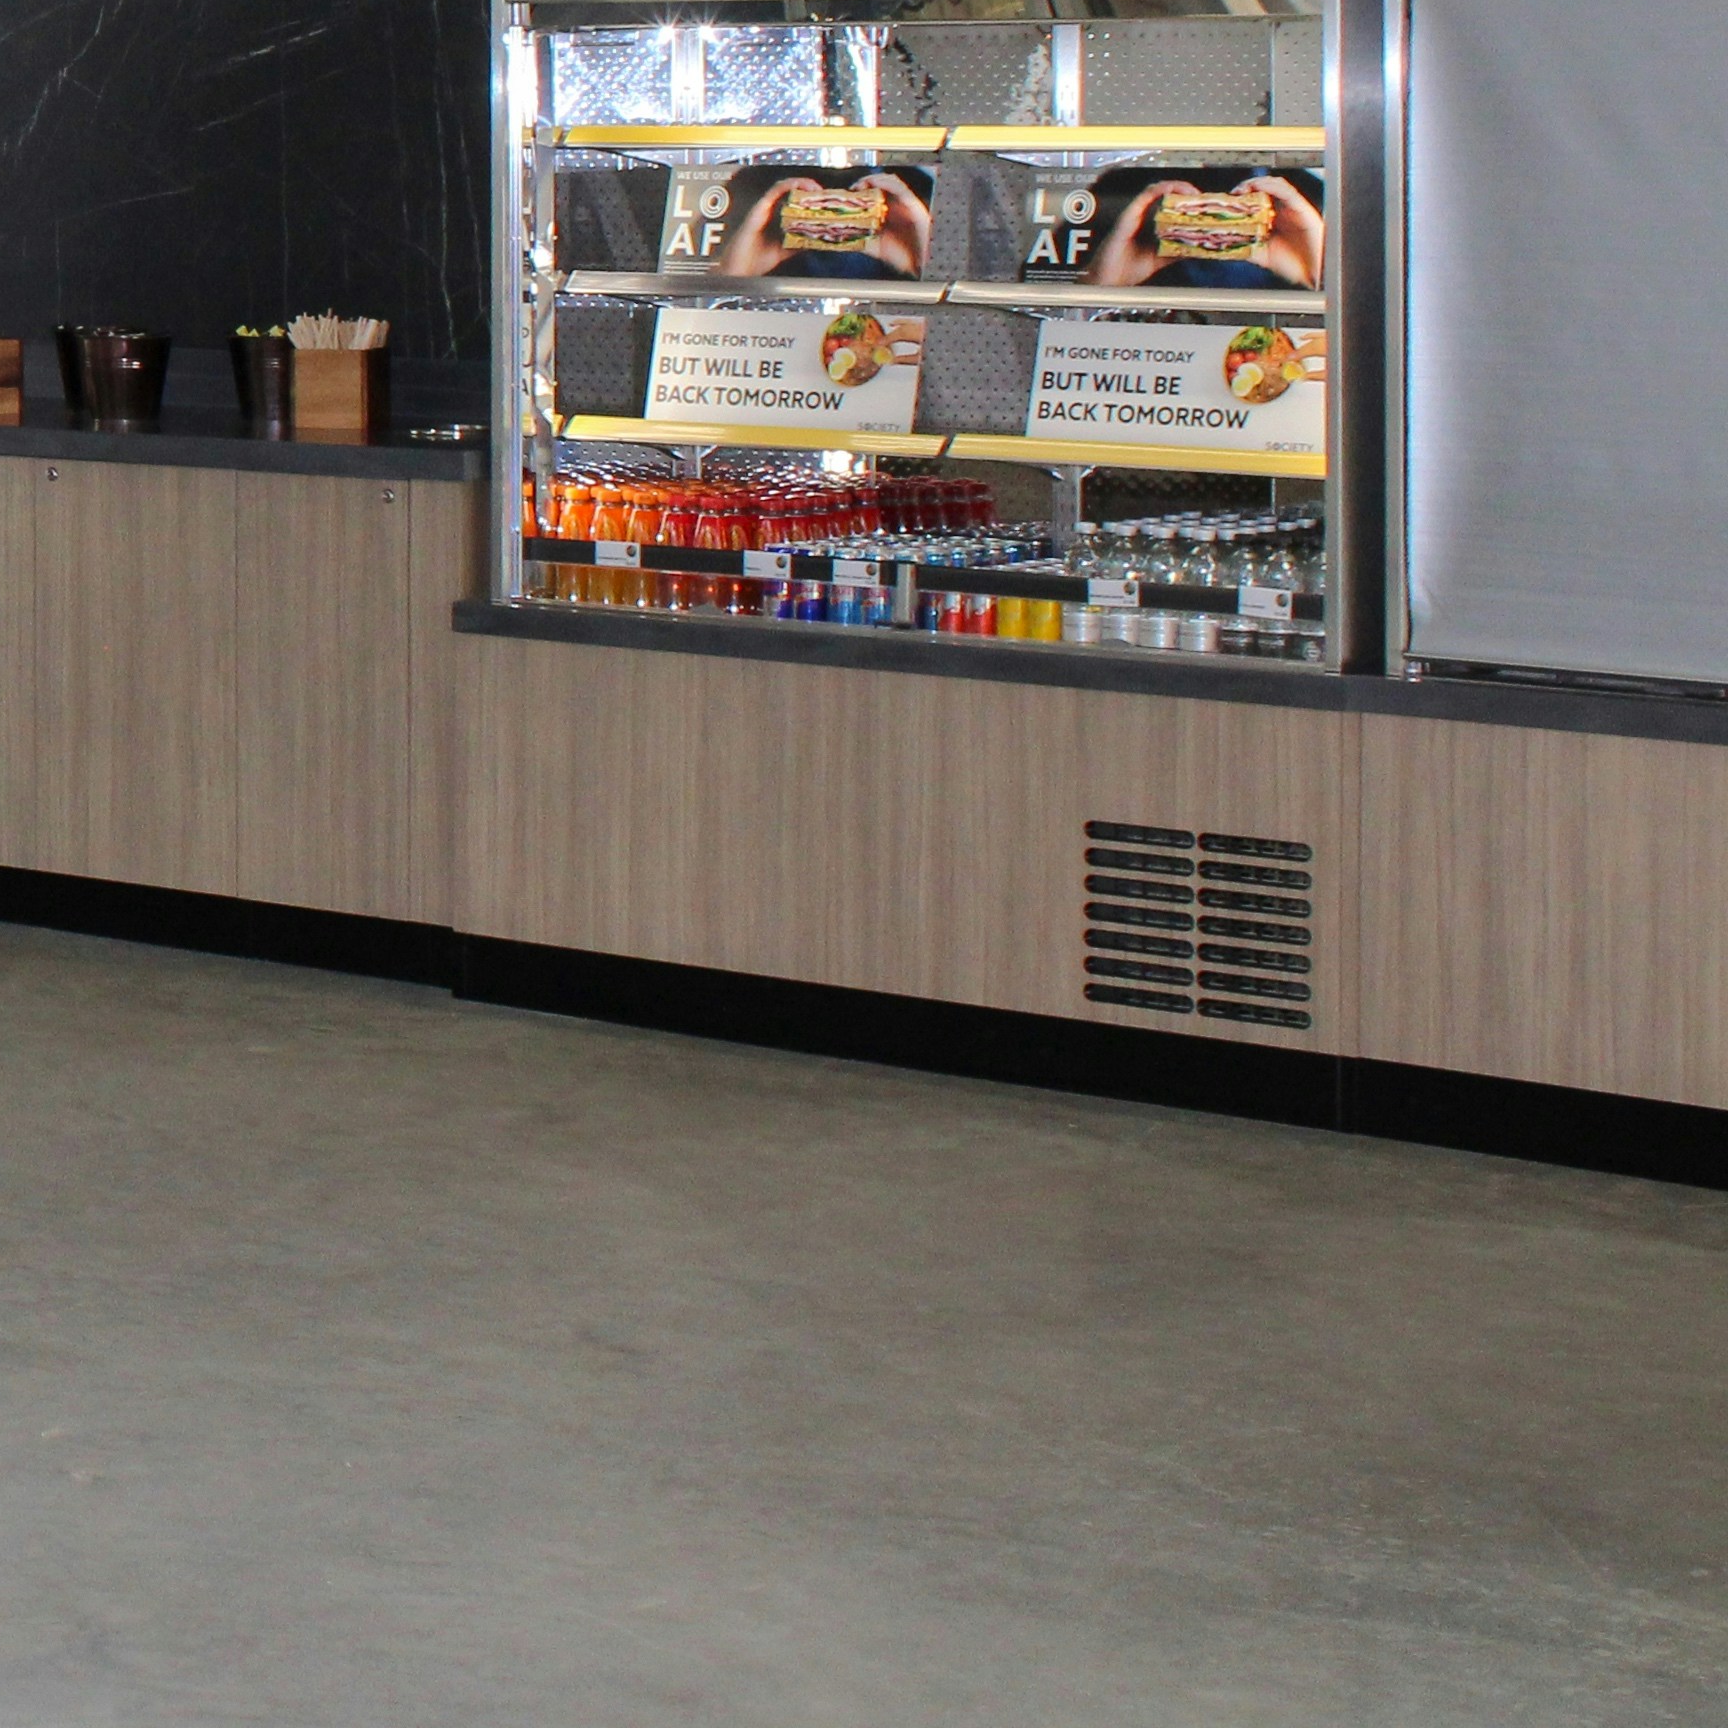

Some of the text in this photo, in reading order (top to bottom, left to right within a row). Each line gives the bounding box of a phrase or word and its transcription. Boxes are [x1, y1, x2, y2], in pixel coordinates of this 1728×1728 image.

[665, 222, 725, 257] AF
[1026, 229, 1092, 265] AF
[661, 332, 796, 349] I'M GONE FOR TODAY
[1044, 346, 1196, 364] I'M GONE FOR TODAY
[659, 356, 784, 379] BUT WILL BE
[1042, 371, 1182, 396] BUT WILL BE
[655, 385, 845, 410] BACK TOMORROW
[857, 421, 902, 433] SOCIETY
[1037, 401, 1251, 429] BACK TOMORROW
[1264, 441, 1315, 453] SOCIETY
